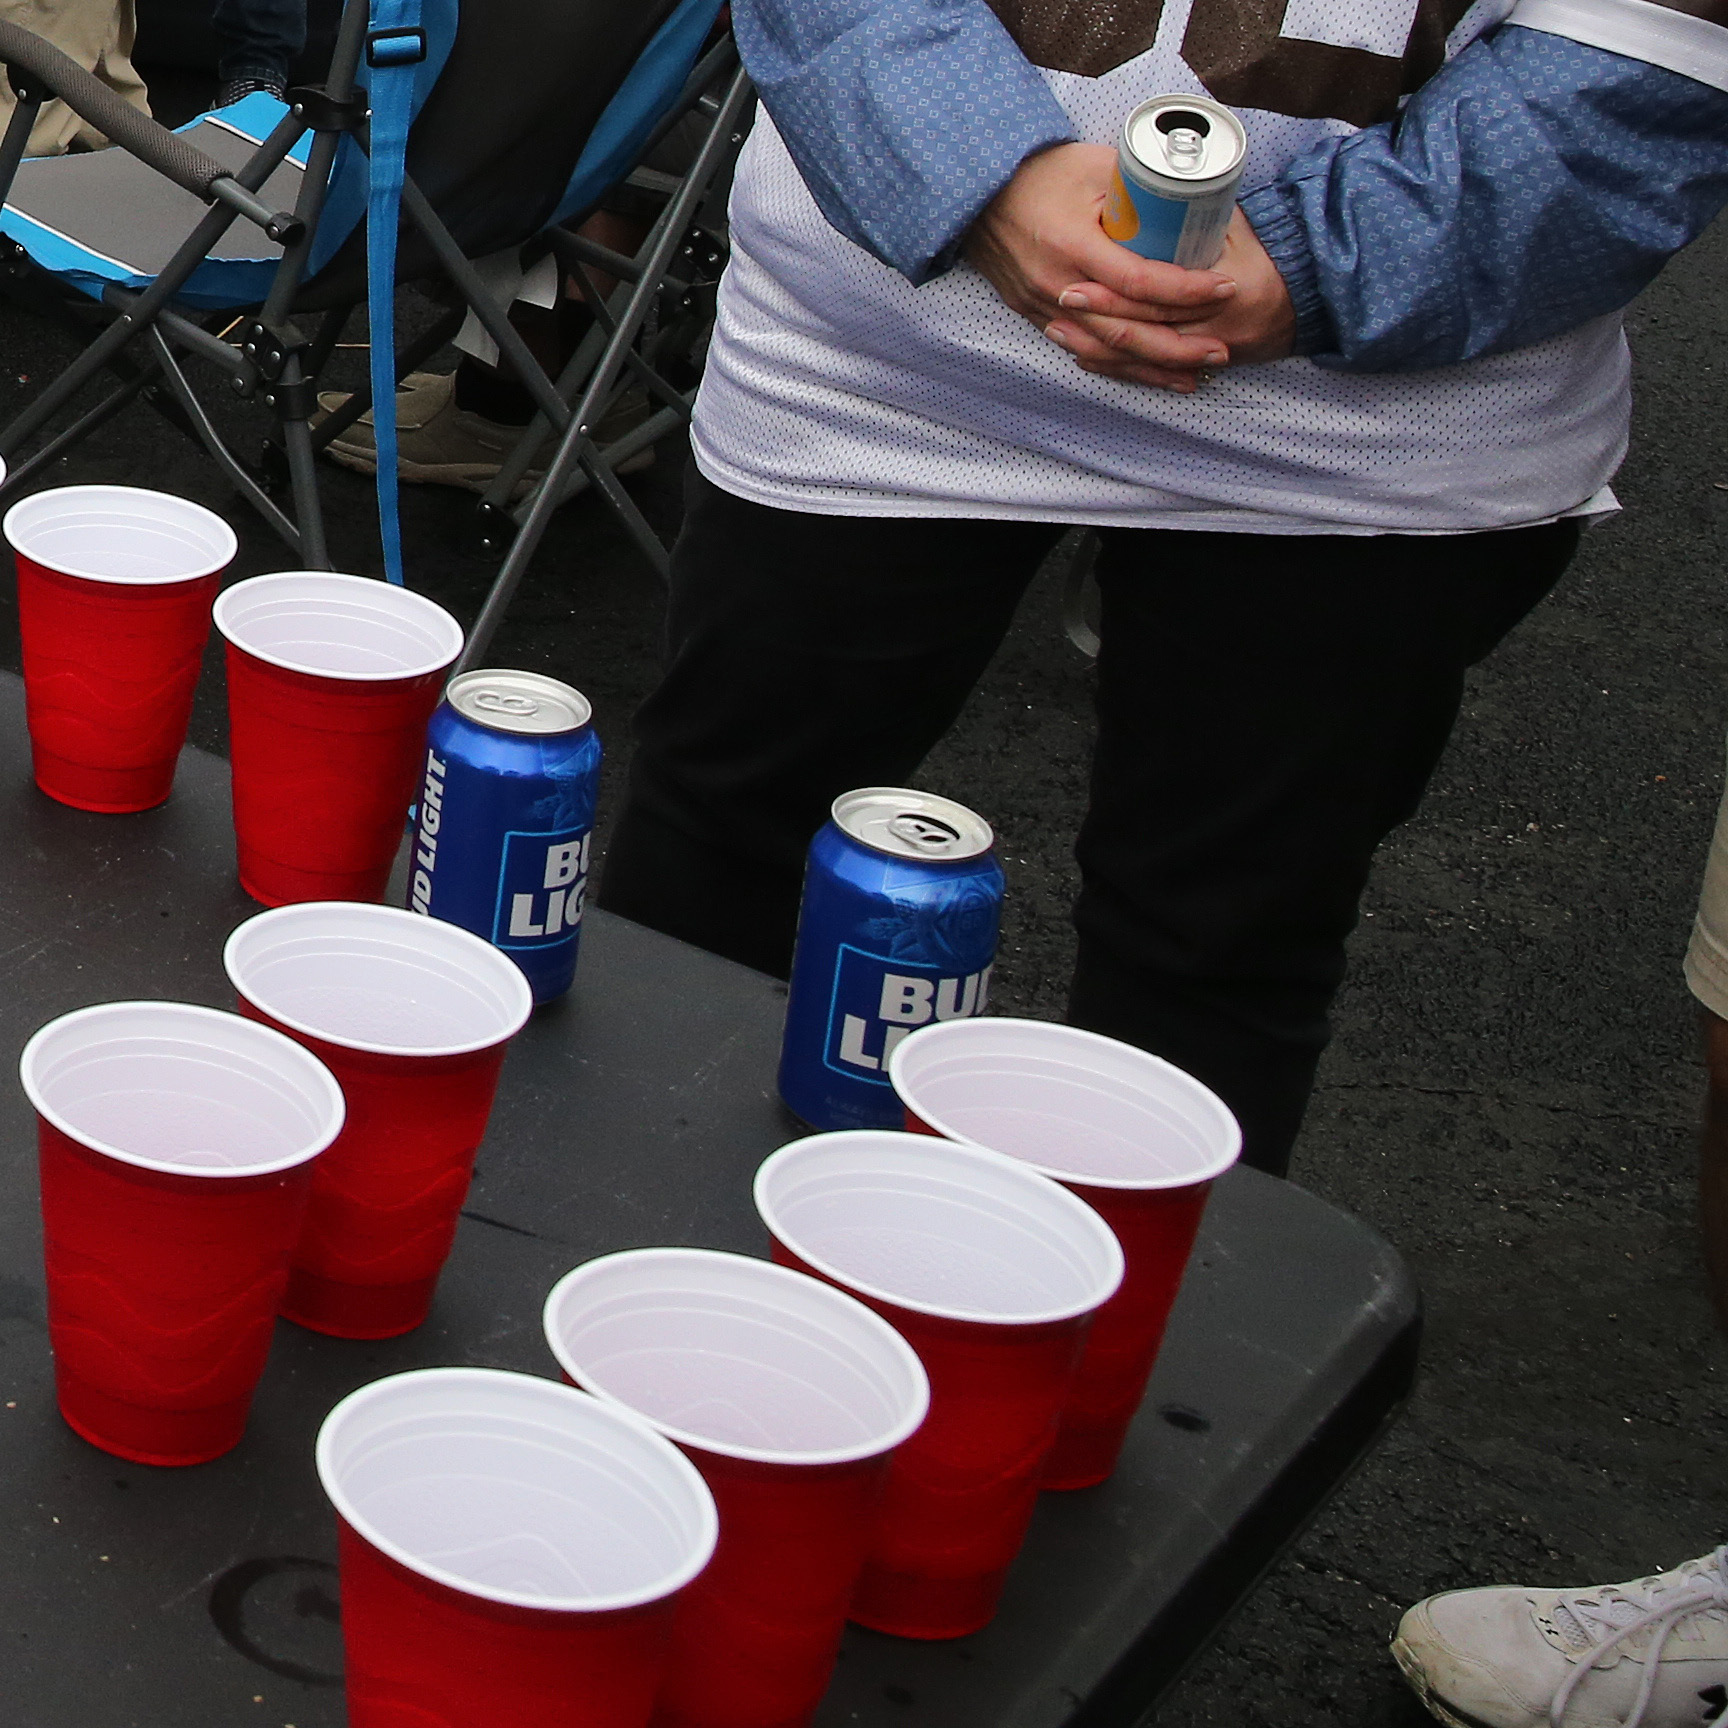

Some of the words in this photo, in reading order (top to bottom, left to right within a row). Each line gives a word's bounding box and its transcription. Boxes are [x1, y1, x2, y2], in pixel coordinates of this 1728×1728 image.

[417, 748, 448, 873] LIGHT
[543, 830, 592, 890] BU
[411, 870, 432, 916] UD
[508, 876, 588, 938] LIG
